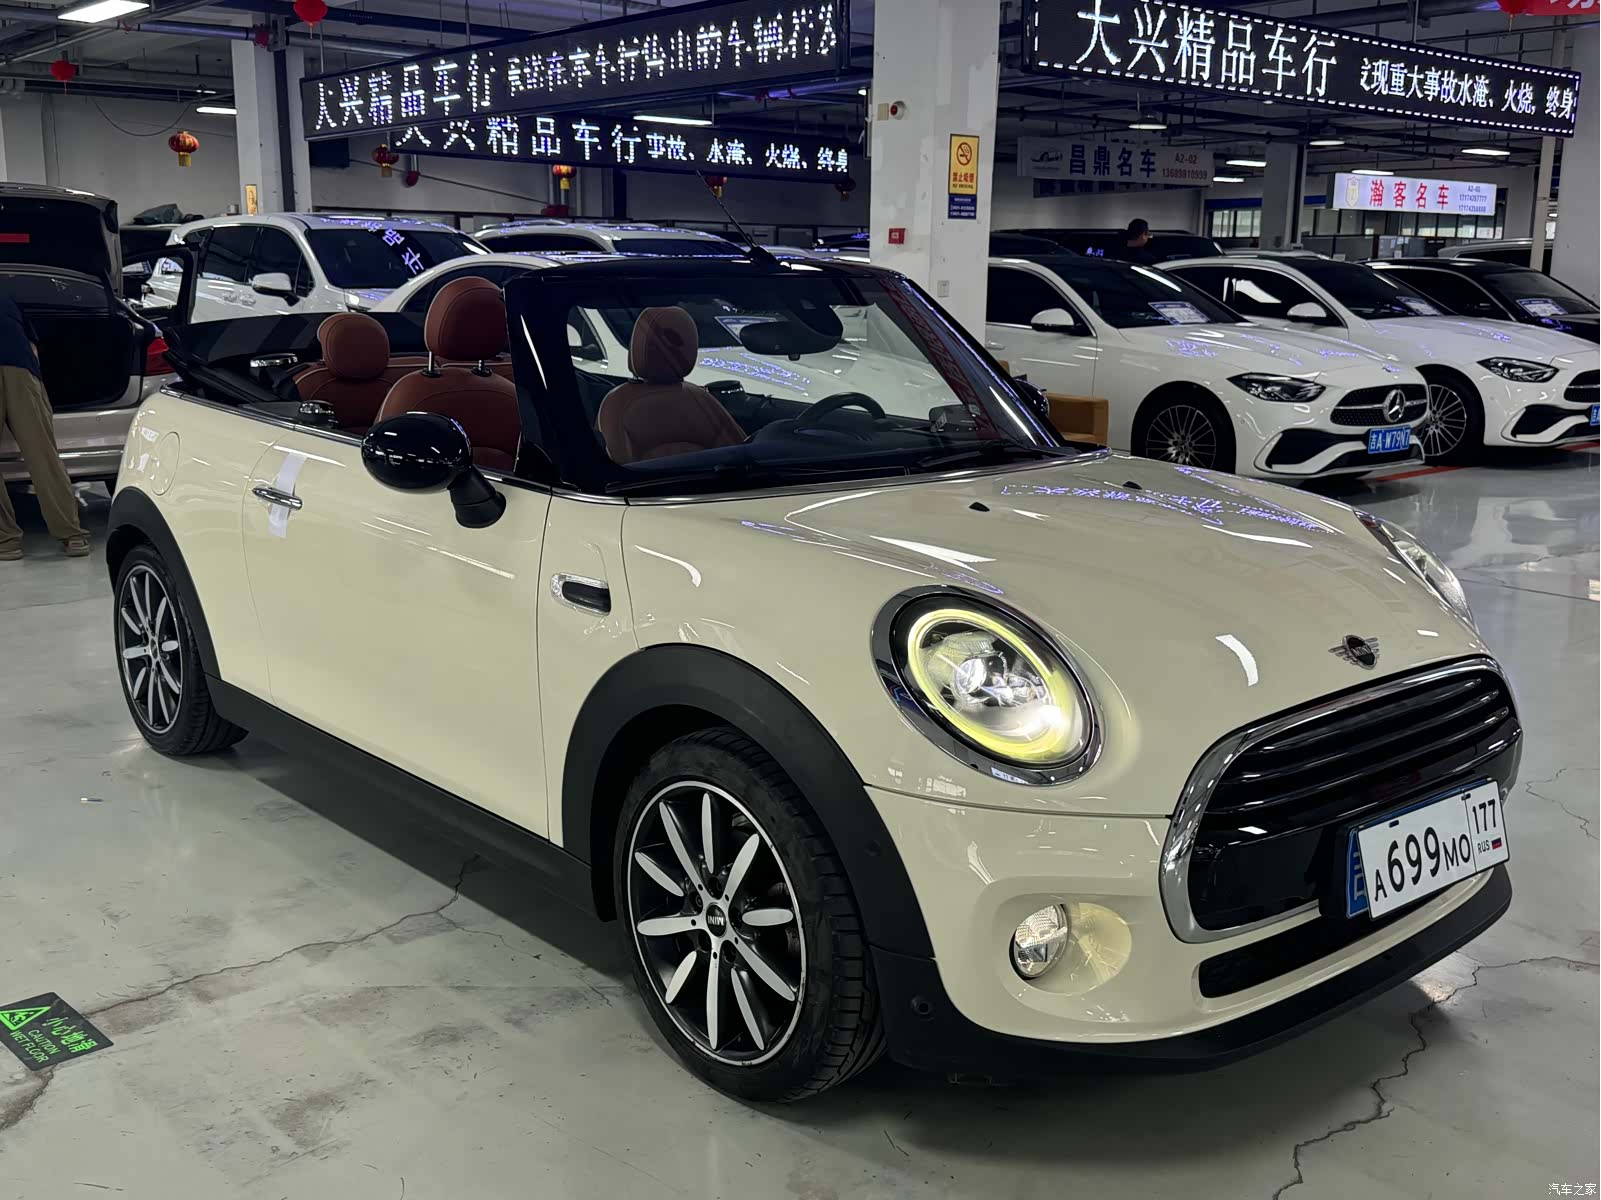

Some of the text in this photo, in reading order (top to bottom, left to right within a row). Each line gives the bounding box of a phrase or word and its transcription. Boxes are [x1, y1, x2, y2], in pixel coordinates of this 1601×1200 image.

[1076, 0, 1337, 97] 大兴精品车行
[1069, 144, 1157, 178] 昌鼎名车
[1369, 179, 1449, 210] 瀚客名车
[1472, 798, 1497, 834] 177
[1477, 839, 1490, 855] RUS
[707, 915, 724, 926] MINI
[9, 1029, 49, 1063] WET FLOOR
[28, 1029, 60, 1055] CAUTION
[42, 1016, 98, 1053] 小心地滑
